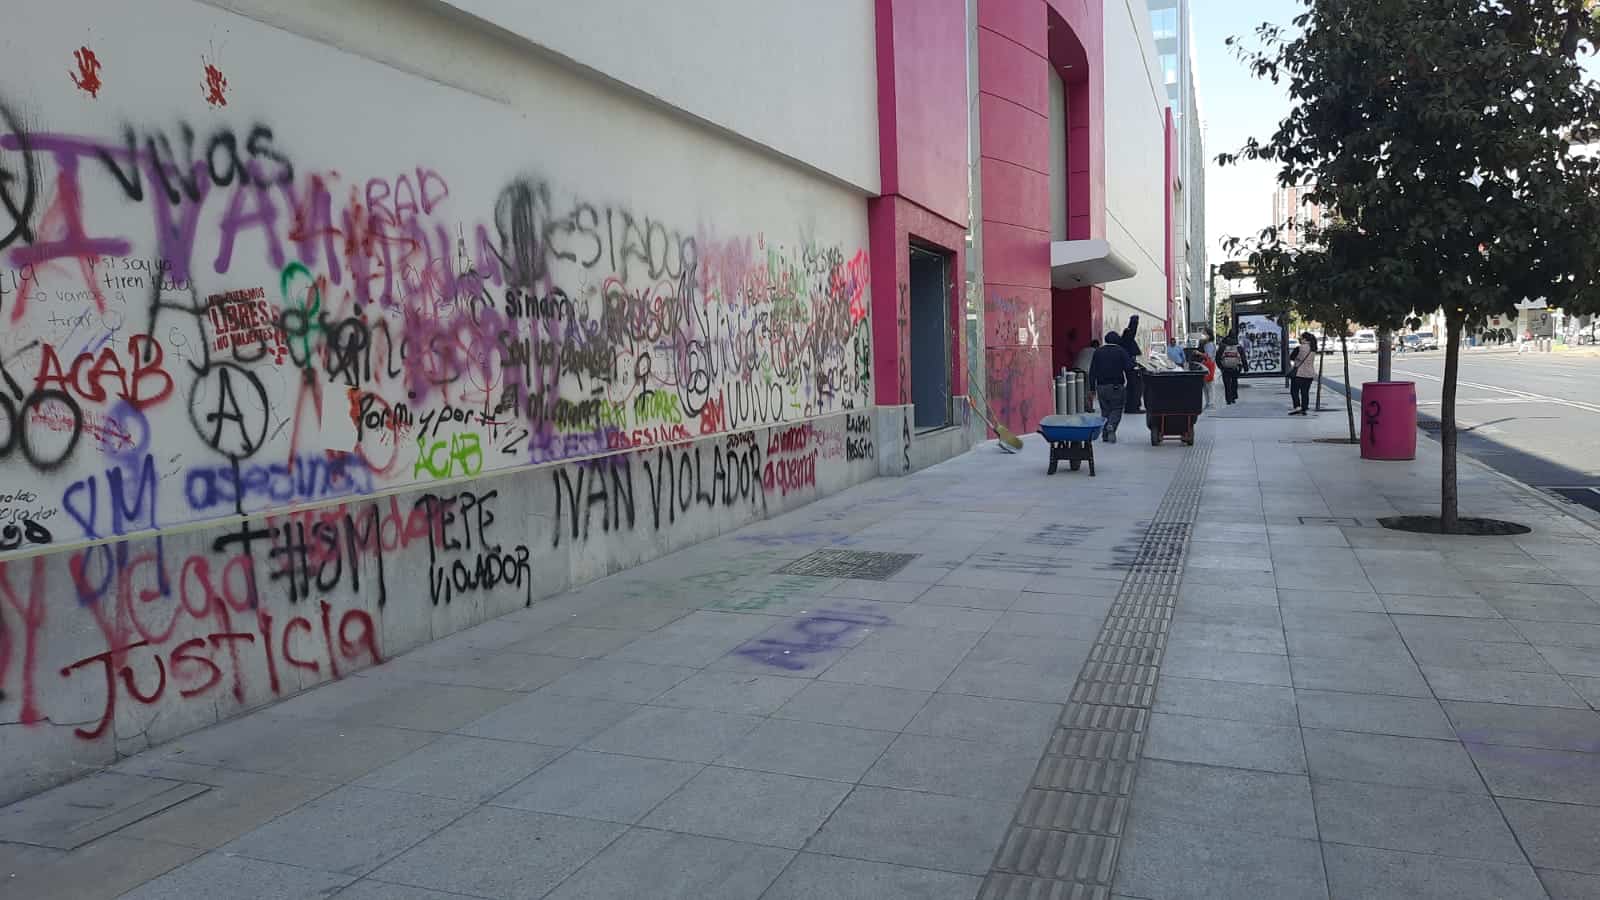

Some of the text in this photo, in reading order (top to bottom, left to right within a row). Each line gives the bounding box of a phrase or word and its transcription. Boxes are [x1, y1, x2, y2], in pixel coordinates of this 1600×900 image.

[33, 332, 175, 413] ACAB
[552, 454, 636, 548] IVAN
[643, 442, 769, 532] VIOLADOR
